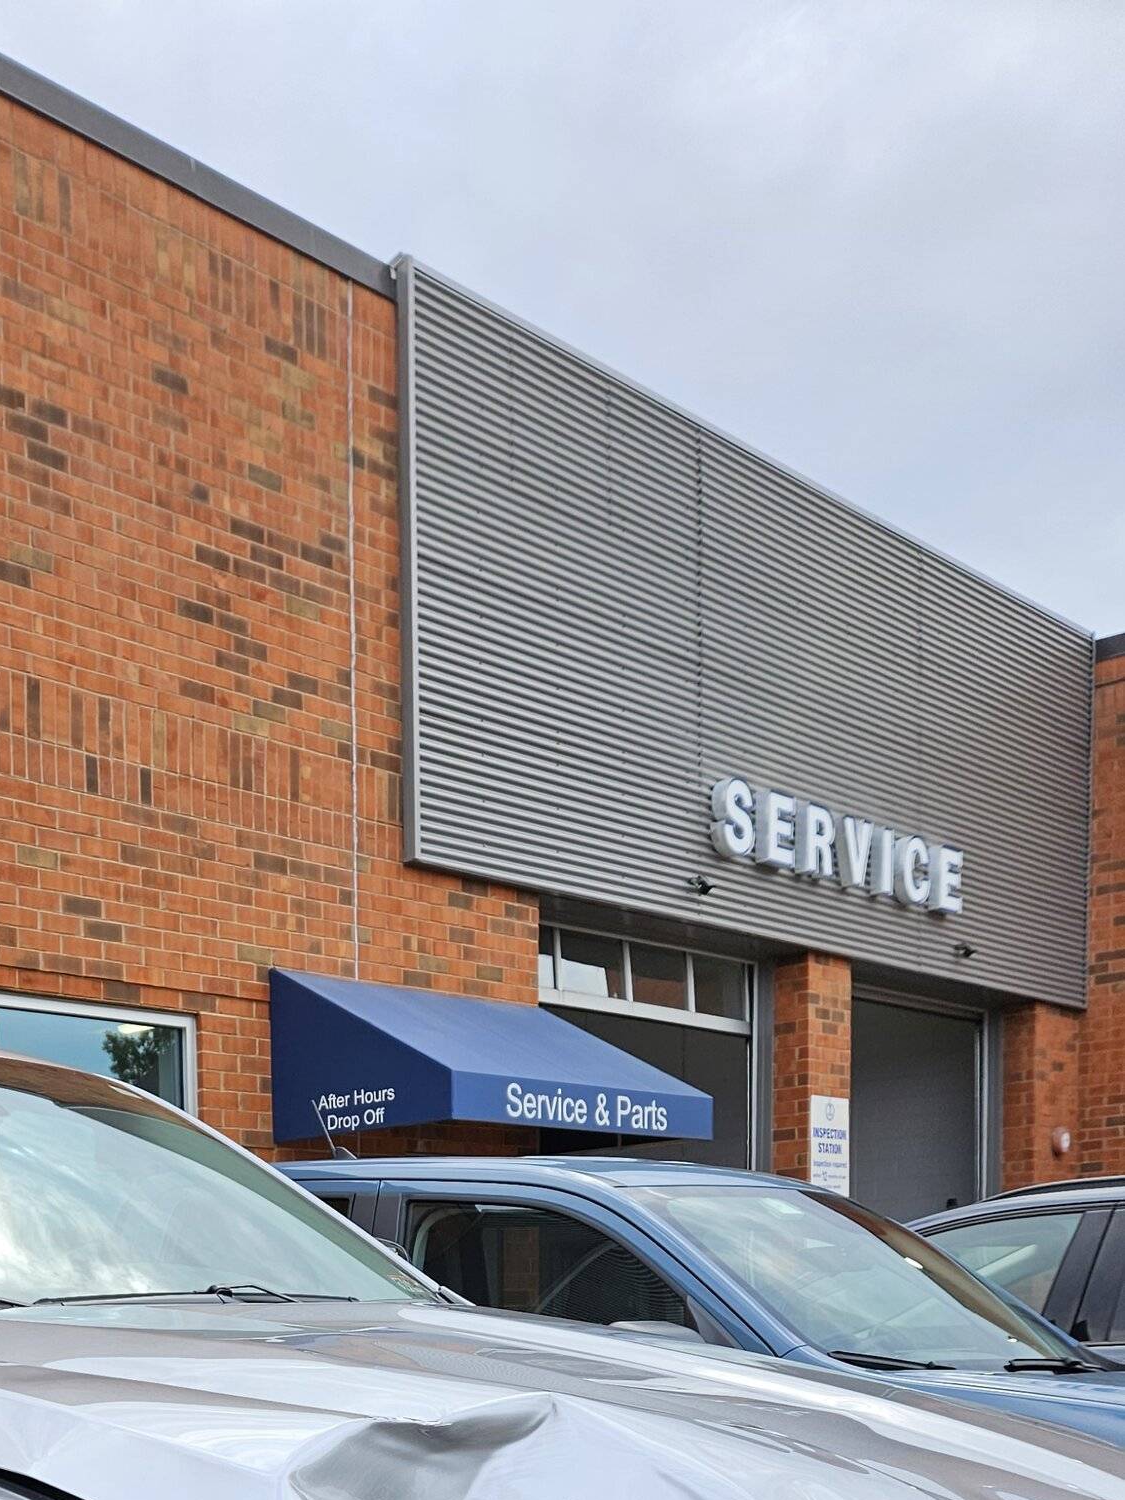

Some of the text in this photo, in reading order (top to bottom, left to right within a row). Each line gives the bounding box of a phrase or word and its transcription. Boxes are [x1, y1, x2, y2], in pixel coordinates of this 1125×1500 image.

[711, 777, 964, 914] SERVICE
[318, 1087, 395, 1110] After Hours
[506, 1082, 668, 1131] Service & Parts
[327, 1107, 385, 1131] Drop Off
[812, 1127, 847, 1140] INSPECTION
[818, 1142, 843, 1154] STATION
